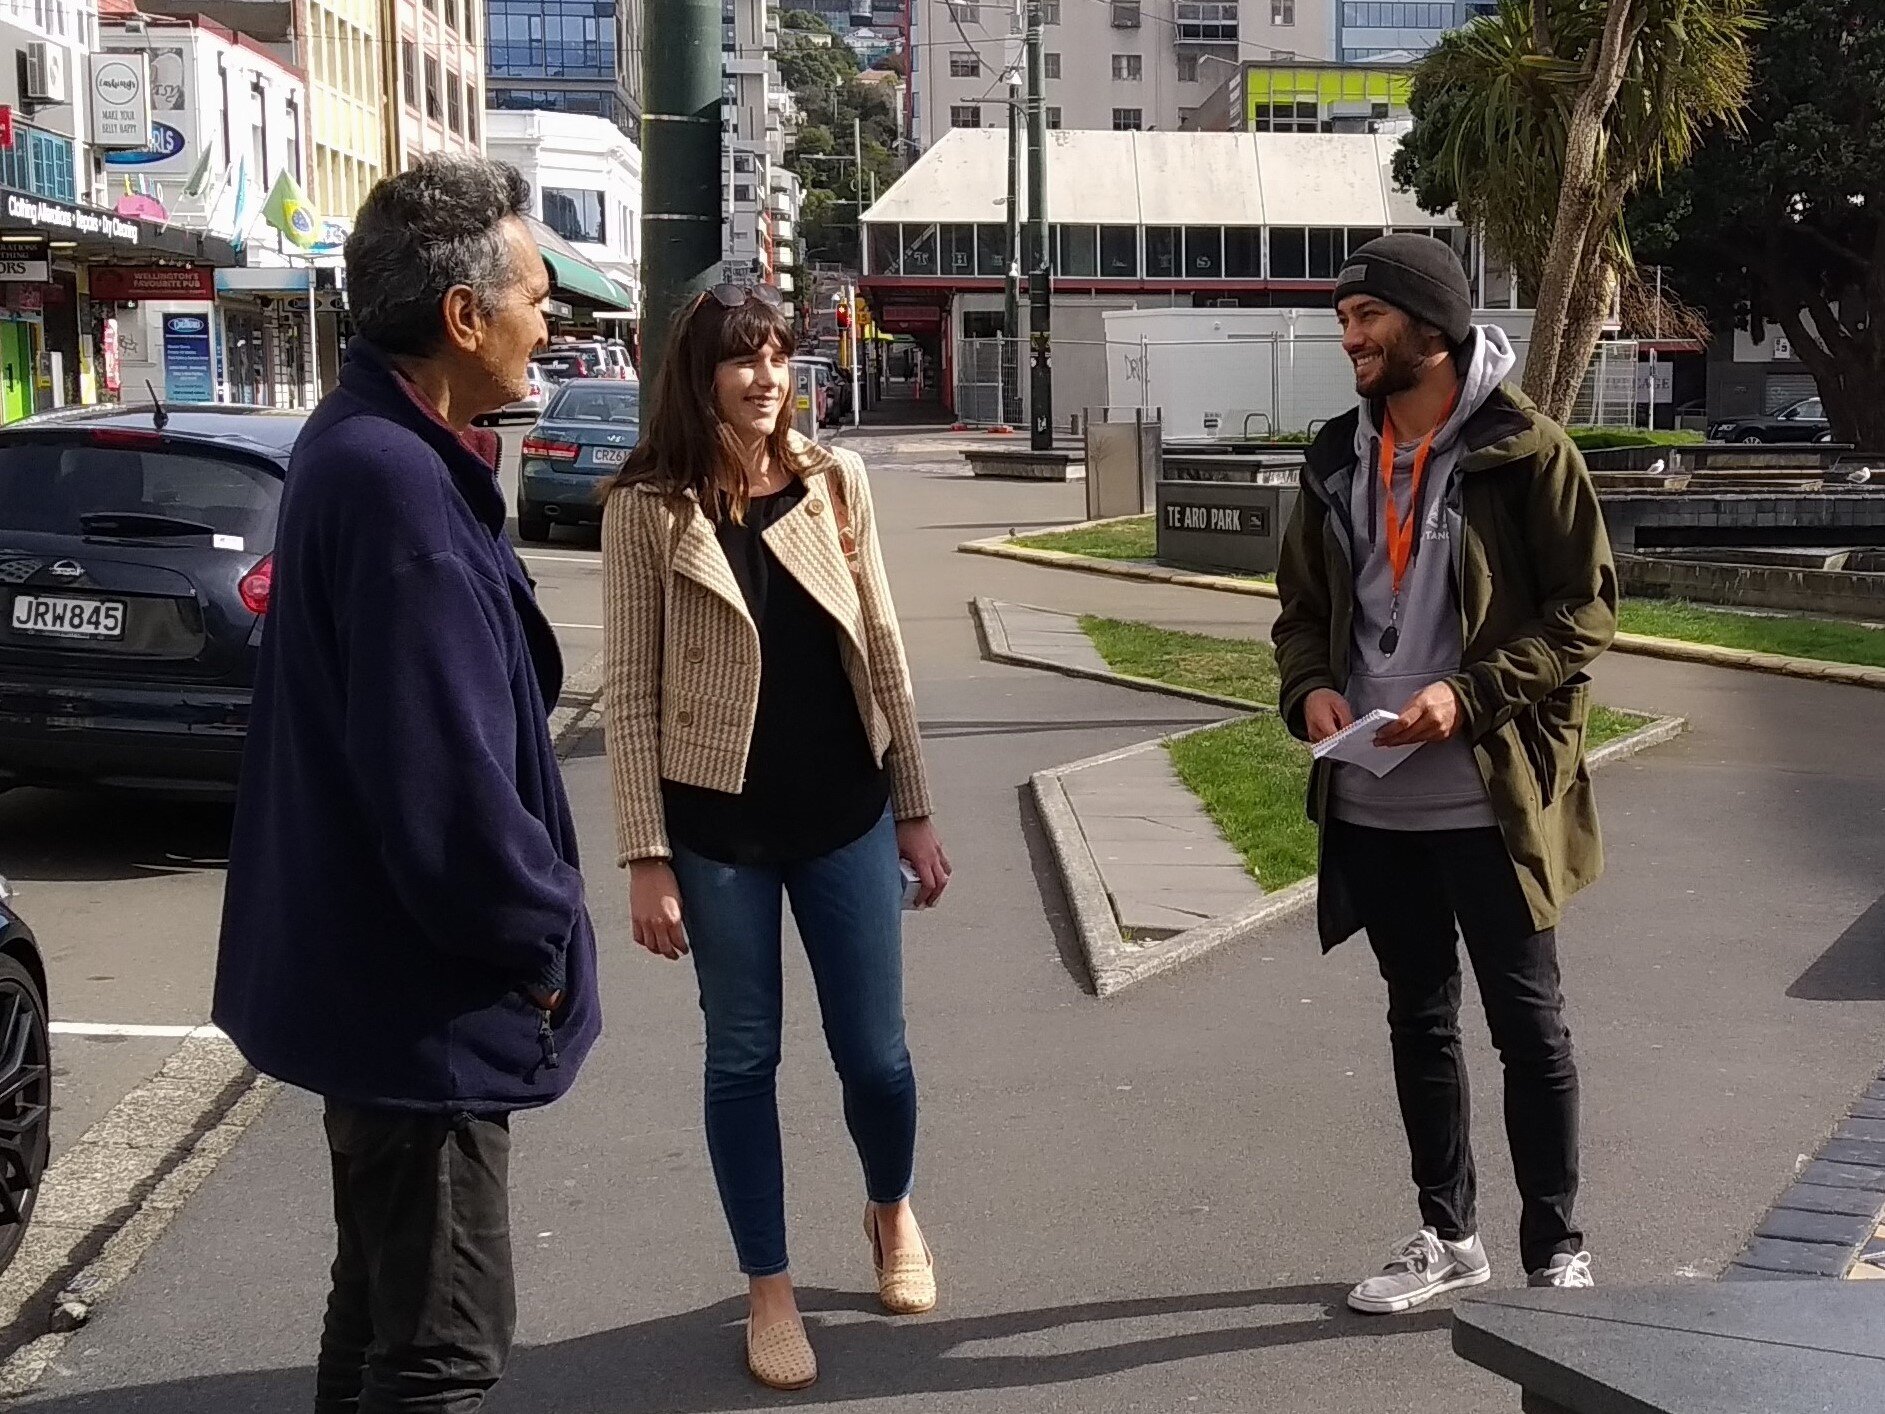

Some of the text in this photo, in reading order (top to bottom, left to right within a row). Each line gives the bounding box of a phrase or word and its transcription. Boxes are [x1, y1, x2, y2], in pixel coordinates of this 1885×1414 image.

[183, 280, 201, 288] PUB
[1167, 505, 1241, 531] TE ARO PARK
[15, 600, 120, 632] JRW845
